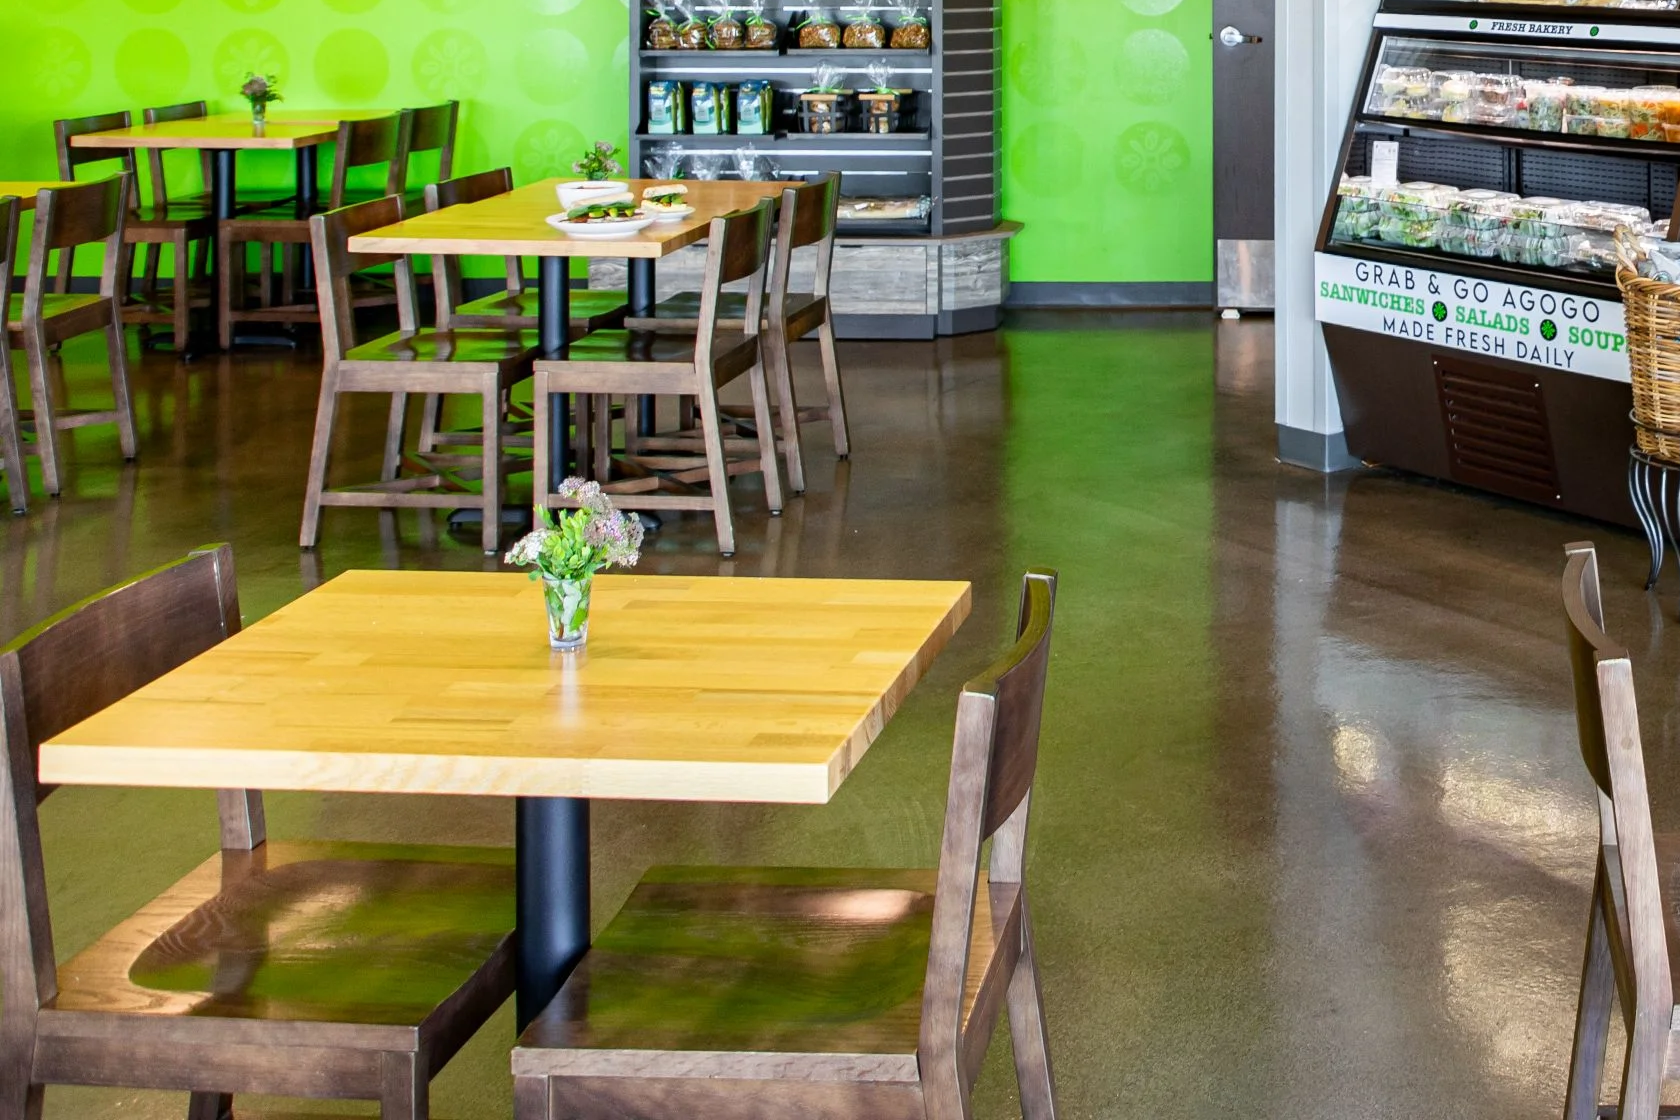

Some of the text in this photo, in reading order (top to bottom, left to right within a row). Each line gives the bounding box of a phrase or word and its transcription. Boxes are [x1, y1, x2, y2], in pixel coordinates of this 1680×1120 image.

[1491, 21, 1574, 35] FRESH BAKERY
[1319, 281, 1629, 354] SANWICHES SALADS SOUP
[1355, 262, 1600, 323] GRAB & GO AGOGO
[1383, 316, 1575, 368] MADE FRESH DAILY
